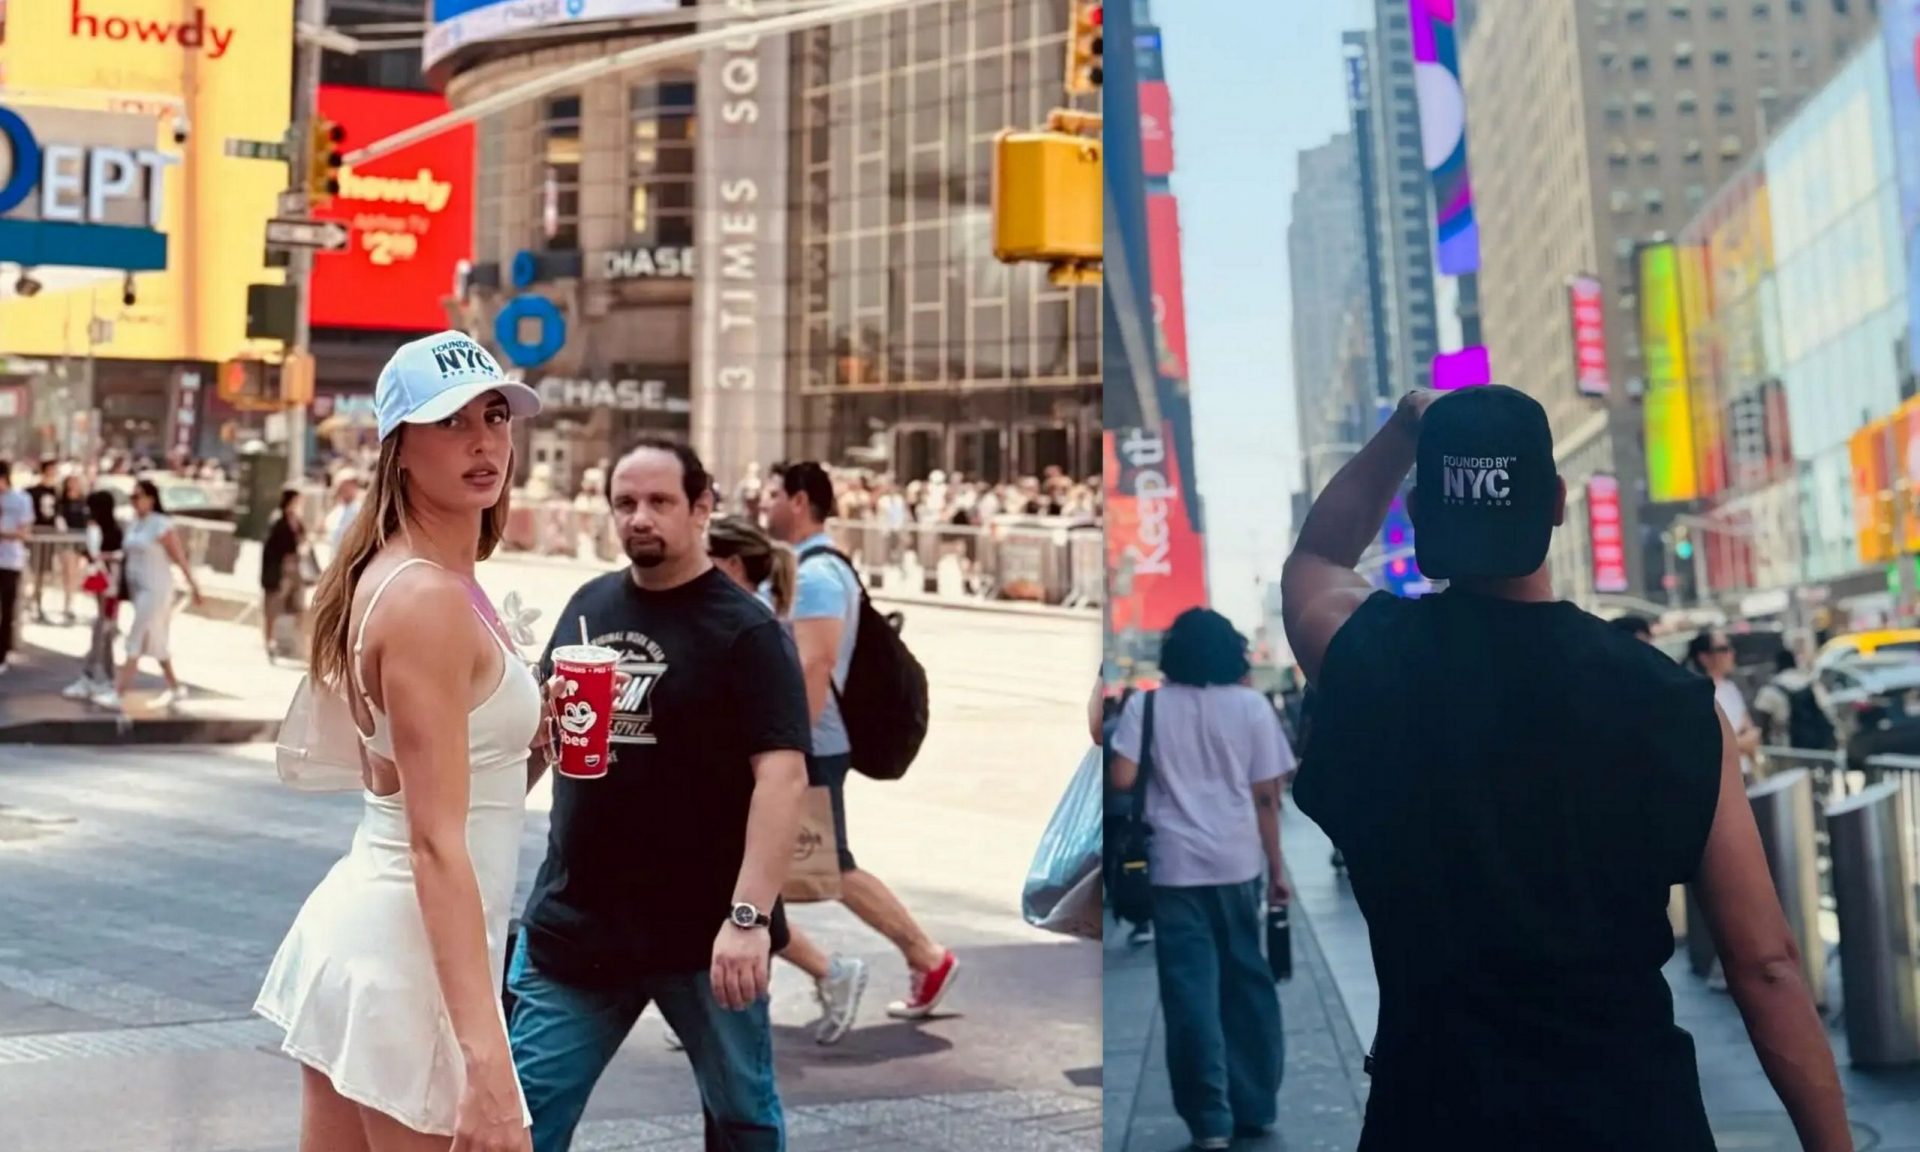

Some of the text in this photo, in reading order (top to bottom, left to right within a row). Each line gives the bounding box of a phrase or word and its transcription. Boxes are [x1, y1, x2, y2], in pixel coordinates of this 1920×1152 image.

[71, 0, 234, 59] howdy
[337, 165, 453, 213] howdy
[720, 177, 758, 333] TIMES
[435, 349, 494, 373] NYC
[539, 377, 666, 410] CHASE
[718, 365, 756, 391] 3
[1443, 455, 1494, 468] FOUNDED
[1444, 466, 1510, 499] NYC
[1133, 470, 1178, 576] Keep
[613, 721, 648, 736] STYLE
